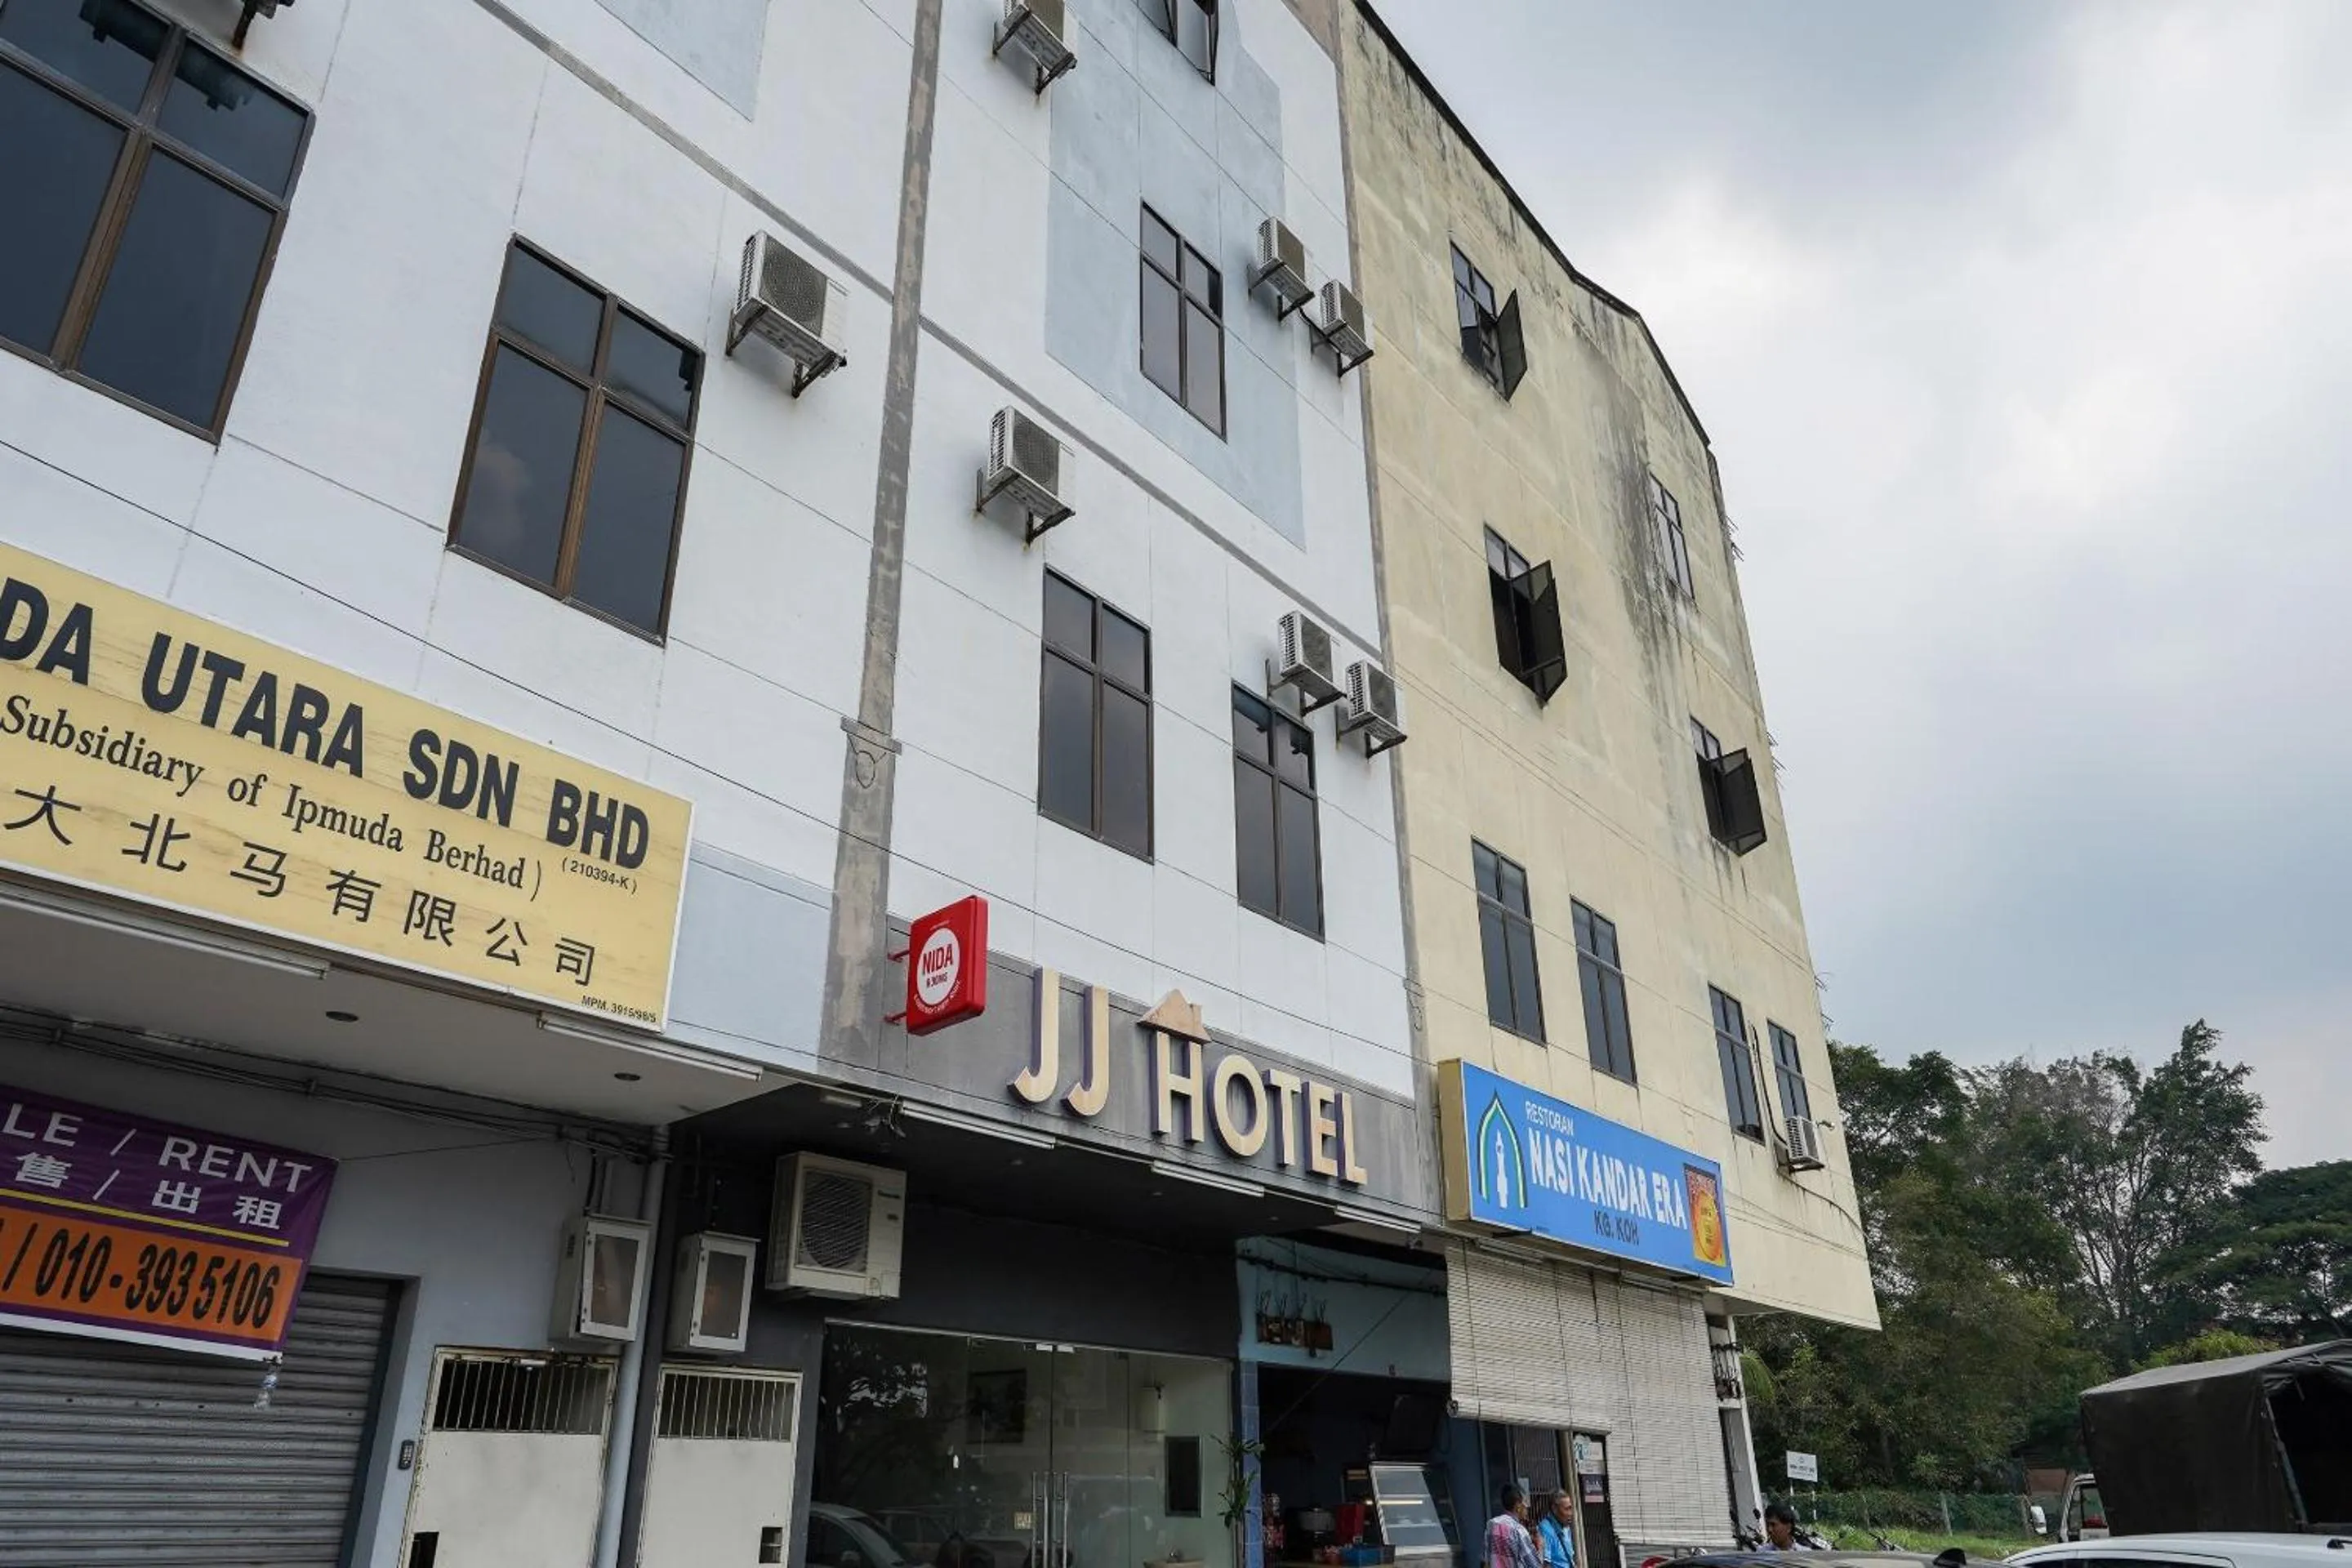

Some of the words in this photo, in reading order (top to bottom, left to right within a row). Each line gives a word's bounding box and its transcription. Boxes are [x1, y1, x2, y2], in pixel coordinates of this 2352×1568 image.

[0, 577, 93, 686] DA
[142, 631, 364, 778] UTARA
[403, 728, 519, 827] SDN
[546, 779, 648, 869] BHD
[0, 695, 204, 797] Subsidiary
[228, 774, 268, 806] of
[283, 784, 403, 852] Ipmuda
[923, 944, 953, 975] NIDA
[1007, 965, 1110, 1116] JJ
[1149, 1031, 1368, 1186] HOTEL
[1526, 1101, 1574, 1136] RESTORAN
[2, 1103, 83, 1147] LE
[158, 1136, 313, 1192] RENT
[15, 1152, 73, 1188] 售
[1528, 1127, 1575, 1196] NASI
[1576, 1145, 1652, 1220] KANDAR
[1652, 1172, 1687, 1230] ERA
